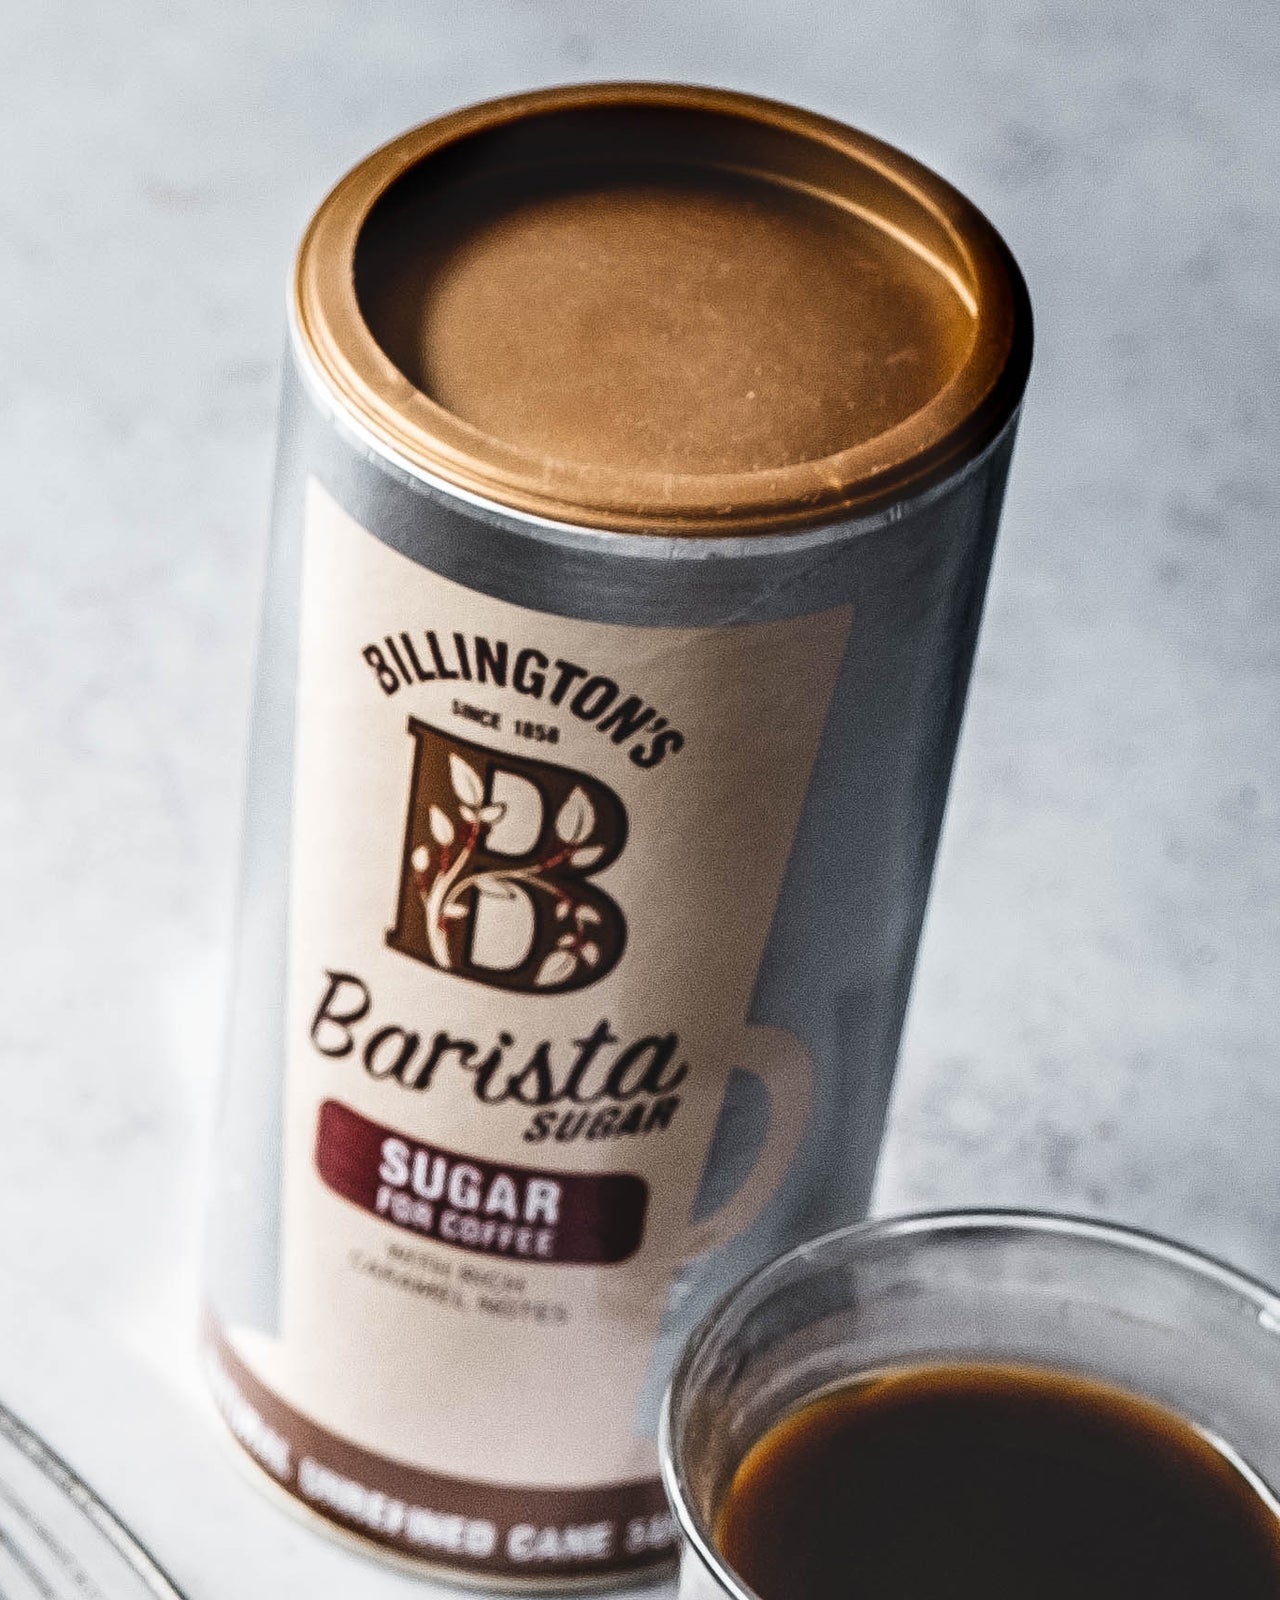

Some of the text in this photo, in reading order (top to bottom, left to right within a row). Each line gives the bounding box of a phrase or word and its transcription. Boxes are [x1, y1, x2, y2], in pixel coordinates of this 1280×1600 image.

[361, 630, 685, 770] BILLINGTON'S
[451, 698, 502, 731] SINCE
[309, 968, 688, 1106] Barista
[522, 1095, 680, 1145] SUGAR
[376, 1185, 556, 1259] FOR COFFEE
[378, 1136, 563, 1226] SUGAR
